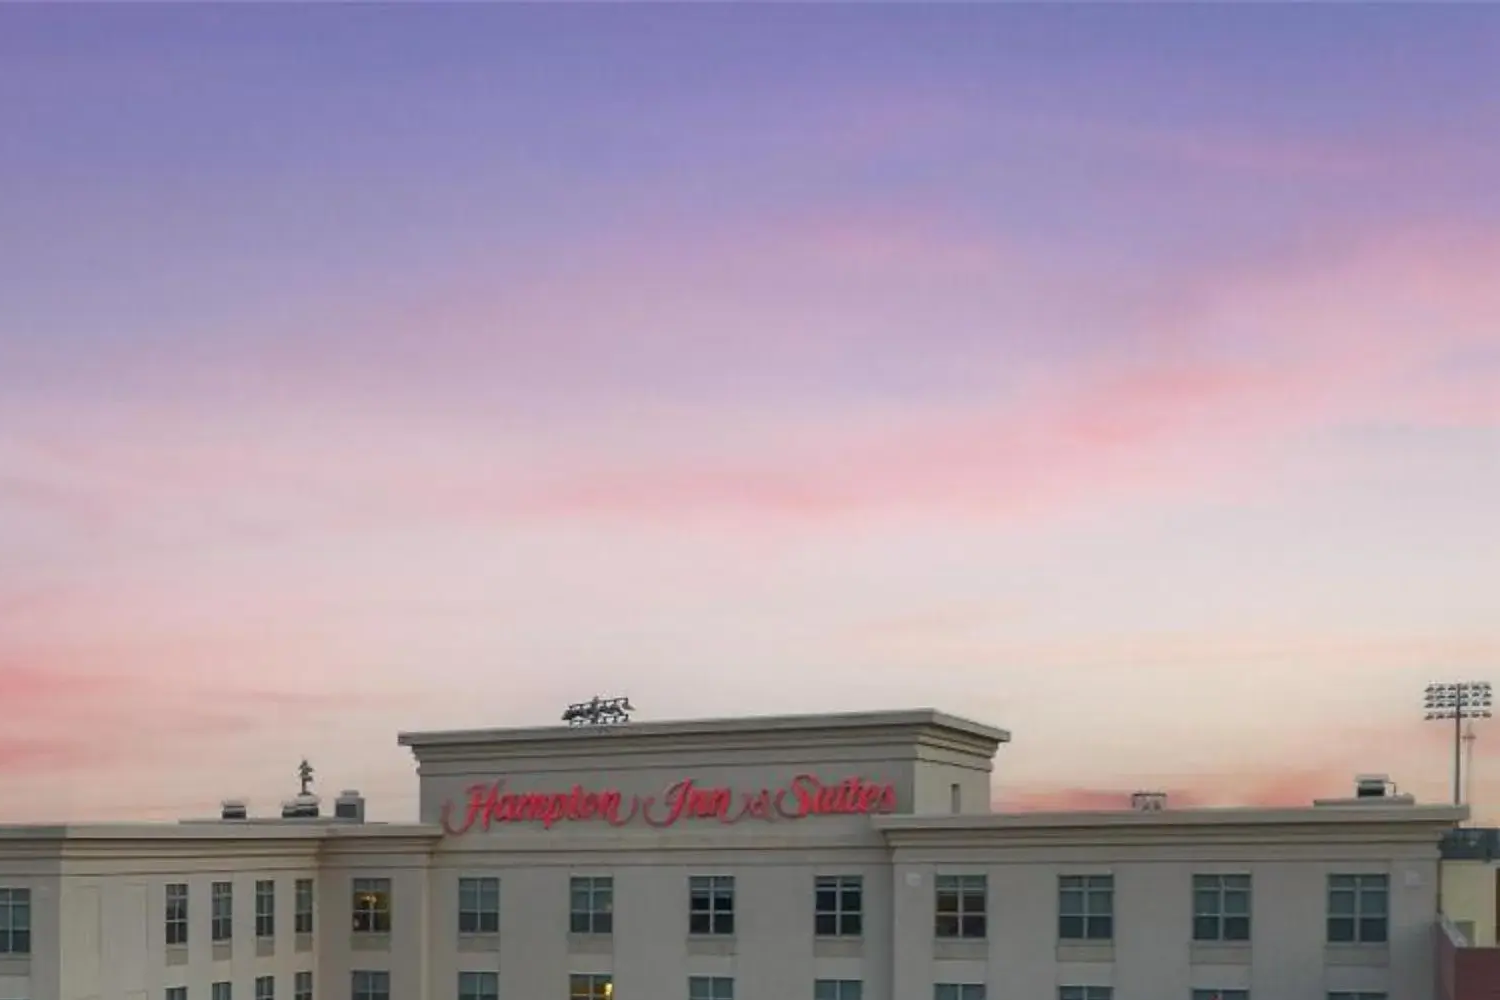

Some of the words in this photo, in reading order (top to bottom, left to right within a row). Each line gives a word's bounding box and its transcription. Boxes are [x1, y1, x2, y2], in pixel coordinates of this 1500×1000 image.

[440, 779, 638, 836] Hampton
[643, 777, 751, 828] Inn
[776, 774, 897, 820] Suites
